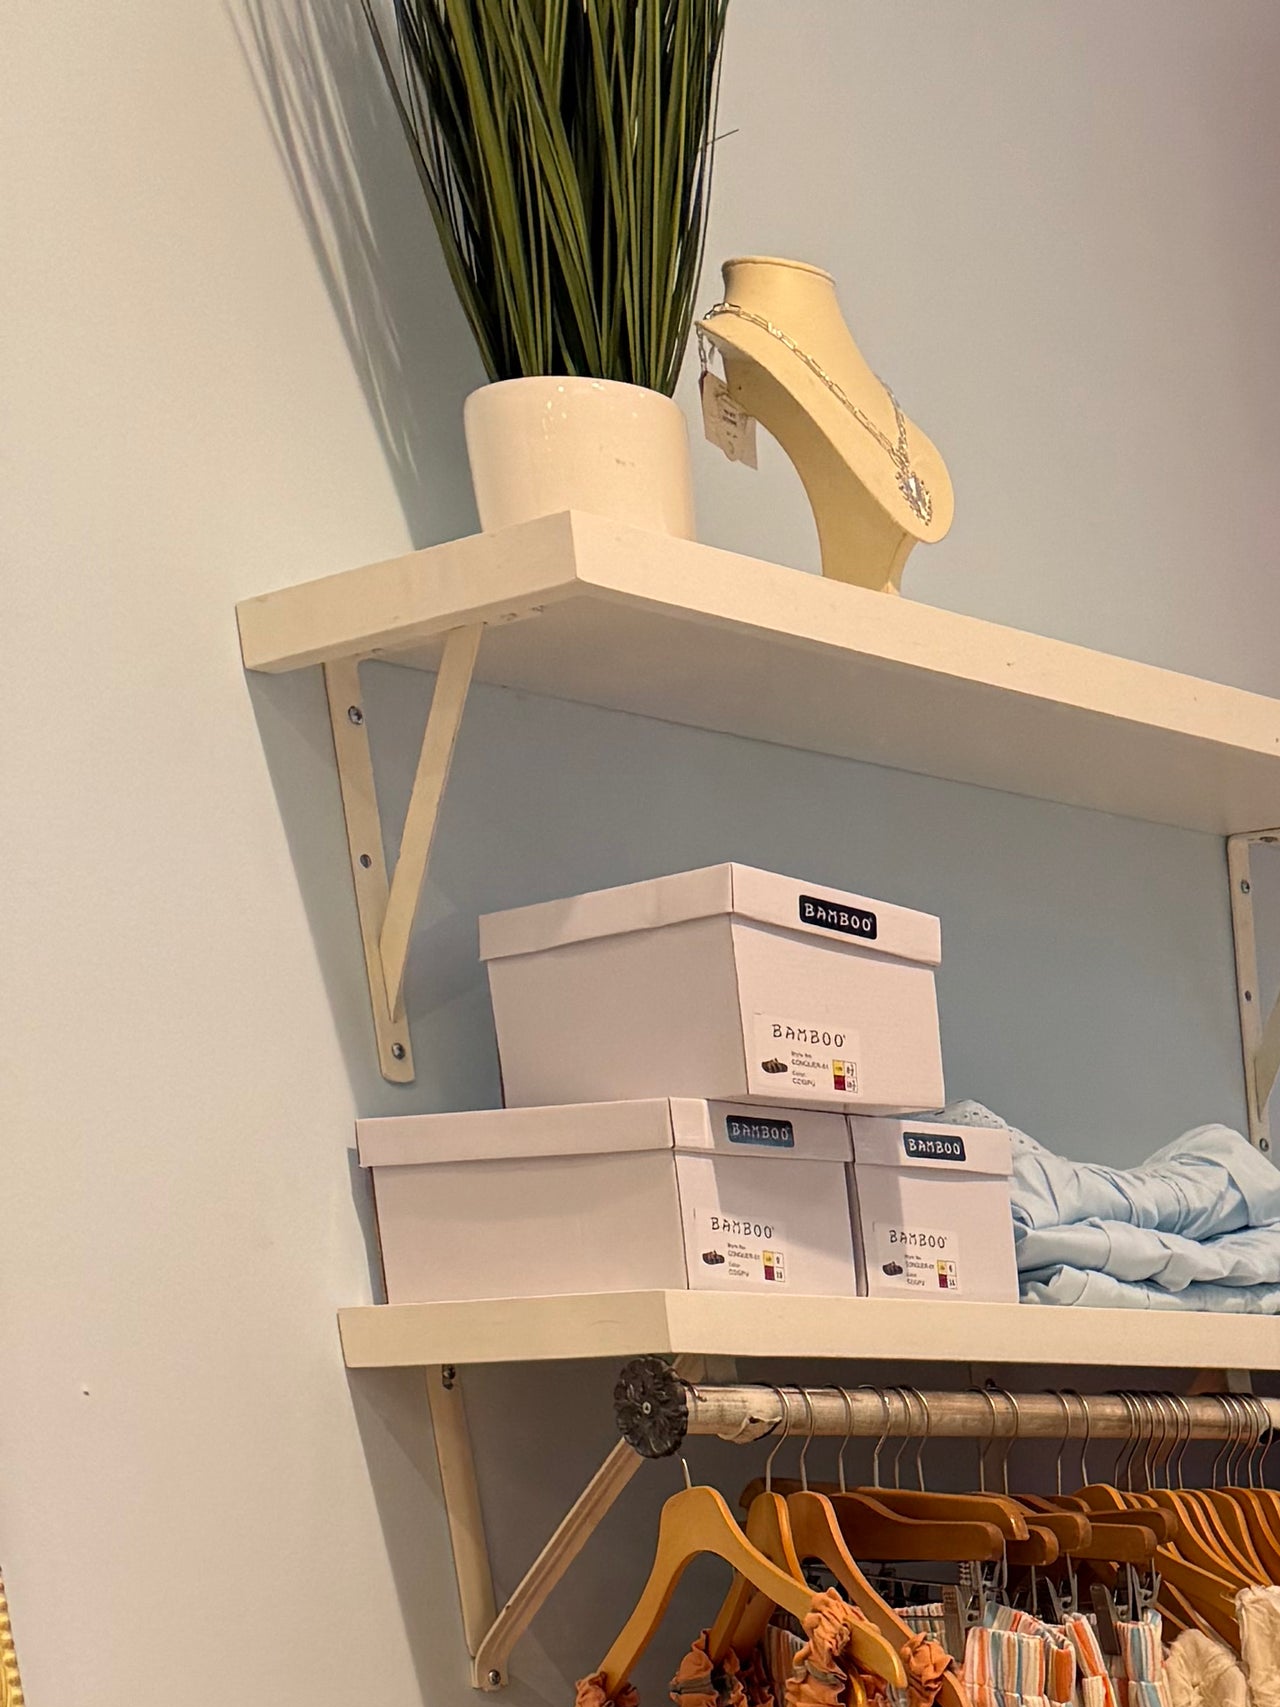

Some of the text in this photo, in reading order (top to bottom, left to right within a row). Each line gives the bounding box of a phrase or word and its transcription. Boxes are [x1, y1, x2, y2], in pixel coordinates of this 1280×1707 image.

[804, 903, 871, 931] BAMBOO
[772, 1023, 843, 1047] BAMBOO
[731, 1122, 788, 1140] BAMBOO
[908, 1138, 960, 1155] BAMBOO
[711, 1216, 772, 1239] BAMBOO
[889, 1229, 945, 1248] BAMBOO
